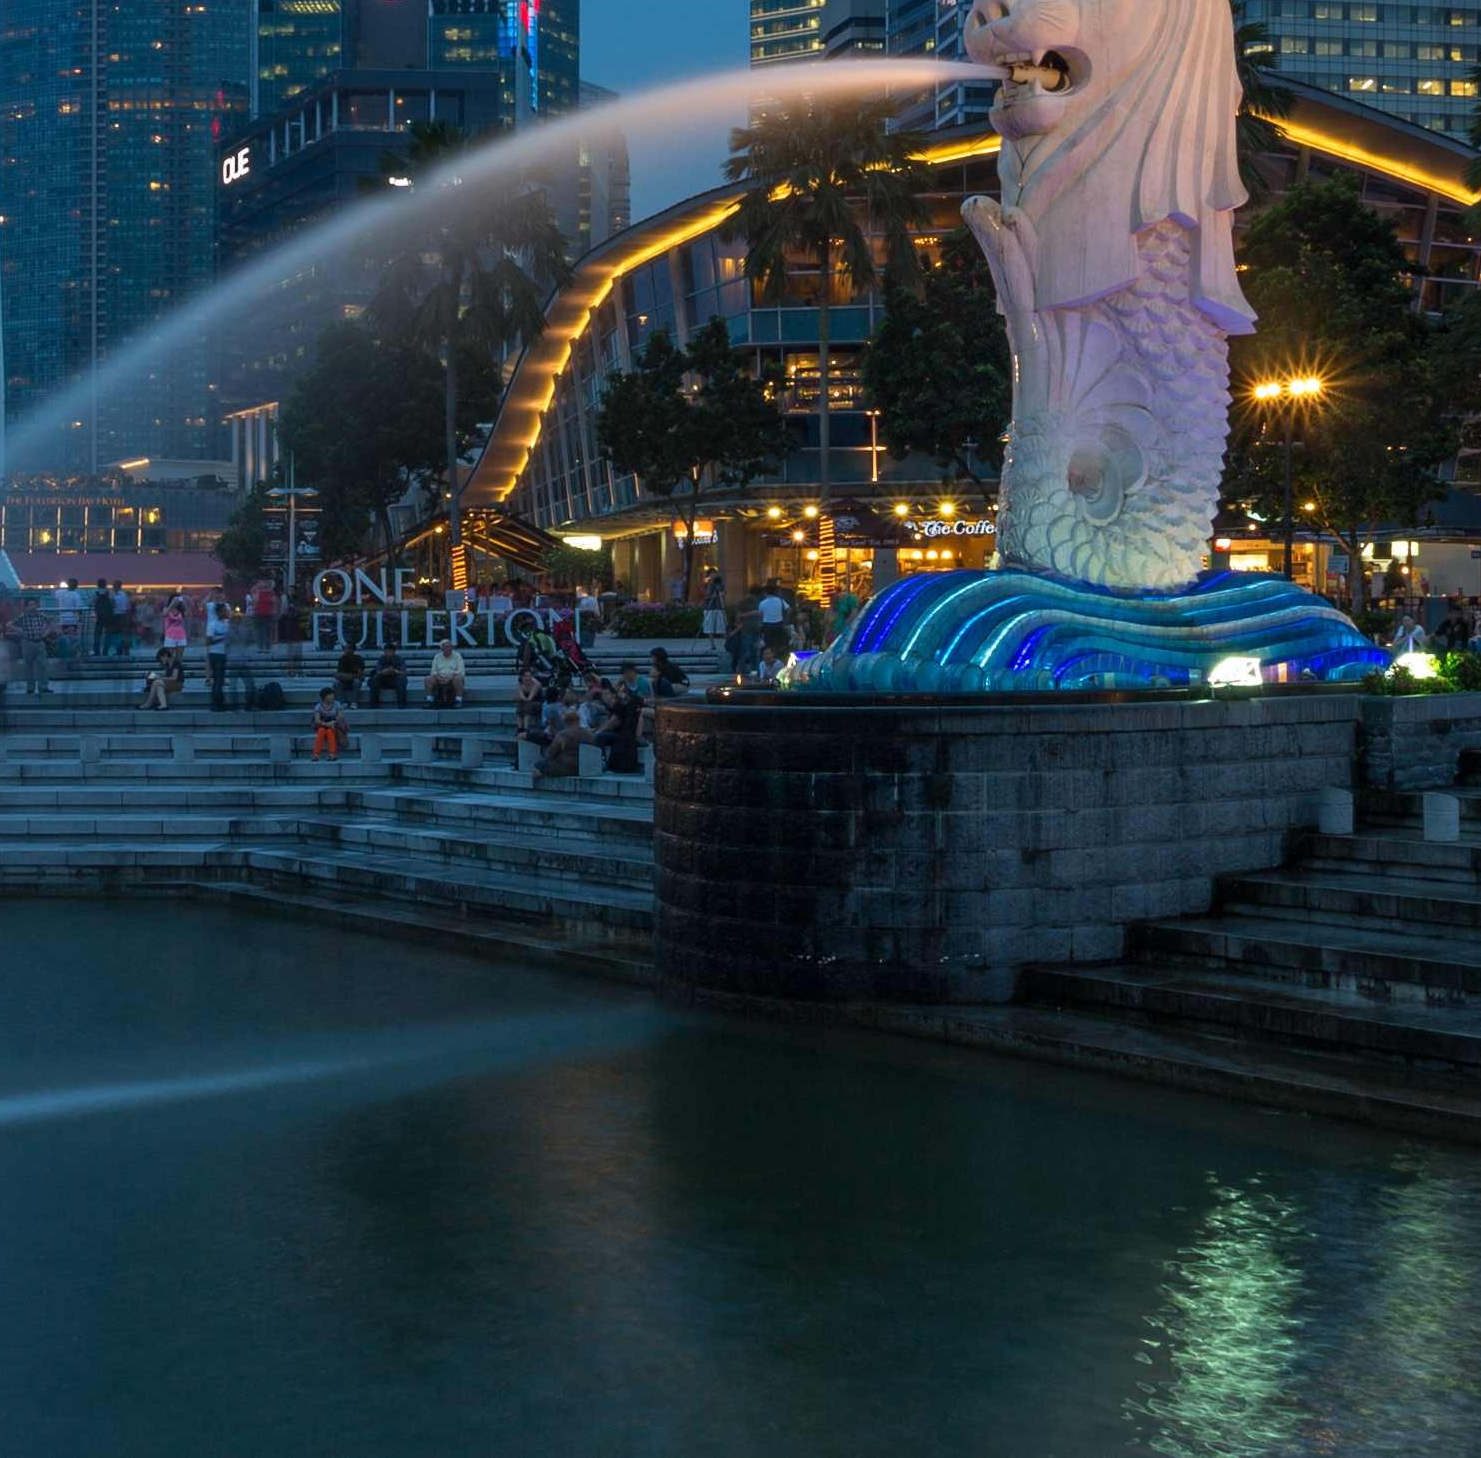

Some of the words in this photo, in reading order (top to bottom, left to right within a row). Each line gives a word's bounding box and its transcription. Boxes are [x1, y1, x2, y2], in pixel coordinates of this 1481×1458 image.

[921, 521, 951, 537] The
[953, 520, 999, 535] Coffe
[312, 566, 416, 607] ONE
[312, 607, 581, 649] FULLERTON
